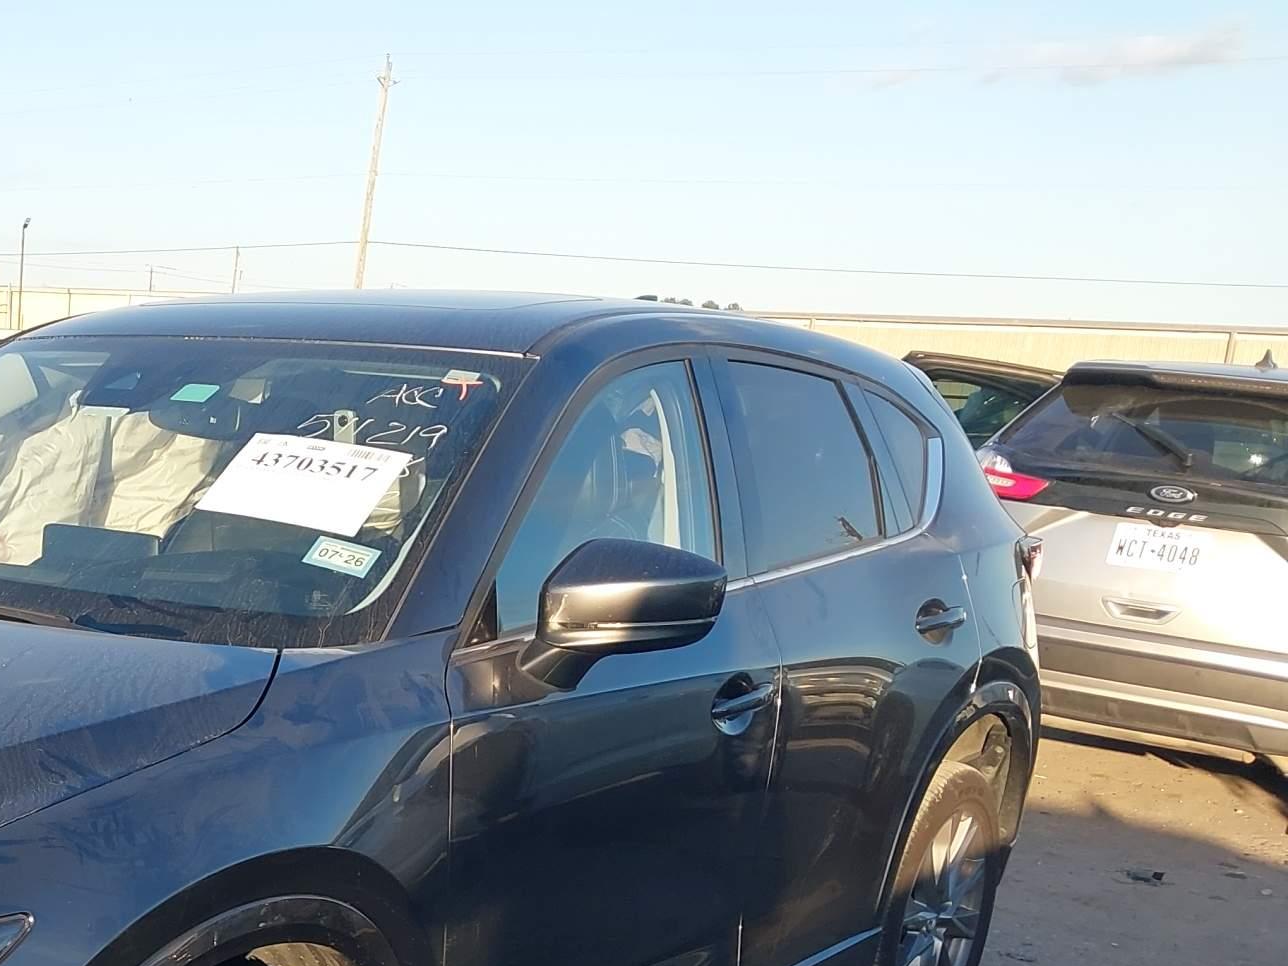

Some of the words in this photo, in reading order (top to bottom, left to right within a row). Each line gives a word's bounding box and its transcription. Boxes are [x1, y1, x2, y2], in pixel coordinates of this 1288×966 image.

[252, 452, 379, 481] 43703517
[1126, 506, 1209, 522] EDGE
[1146, 528, 1182, 541] TEXAS
